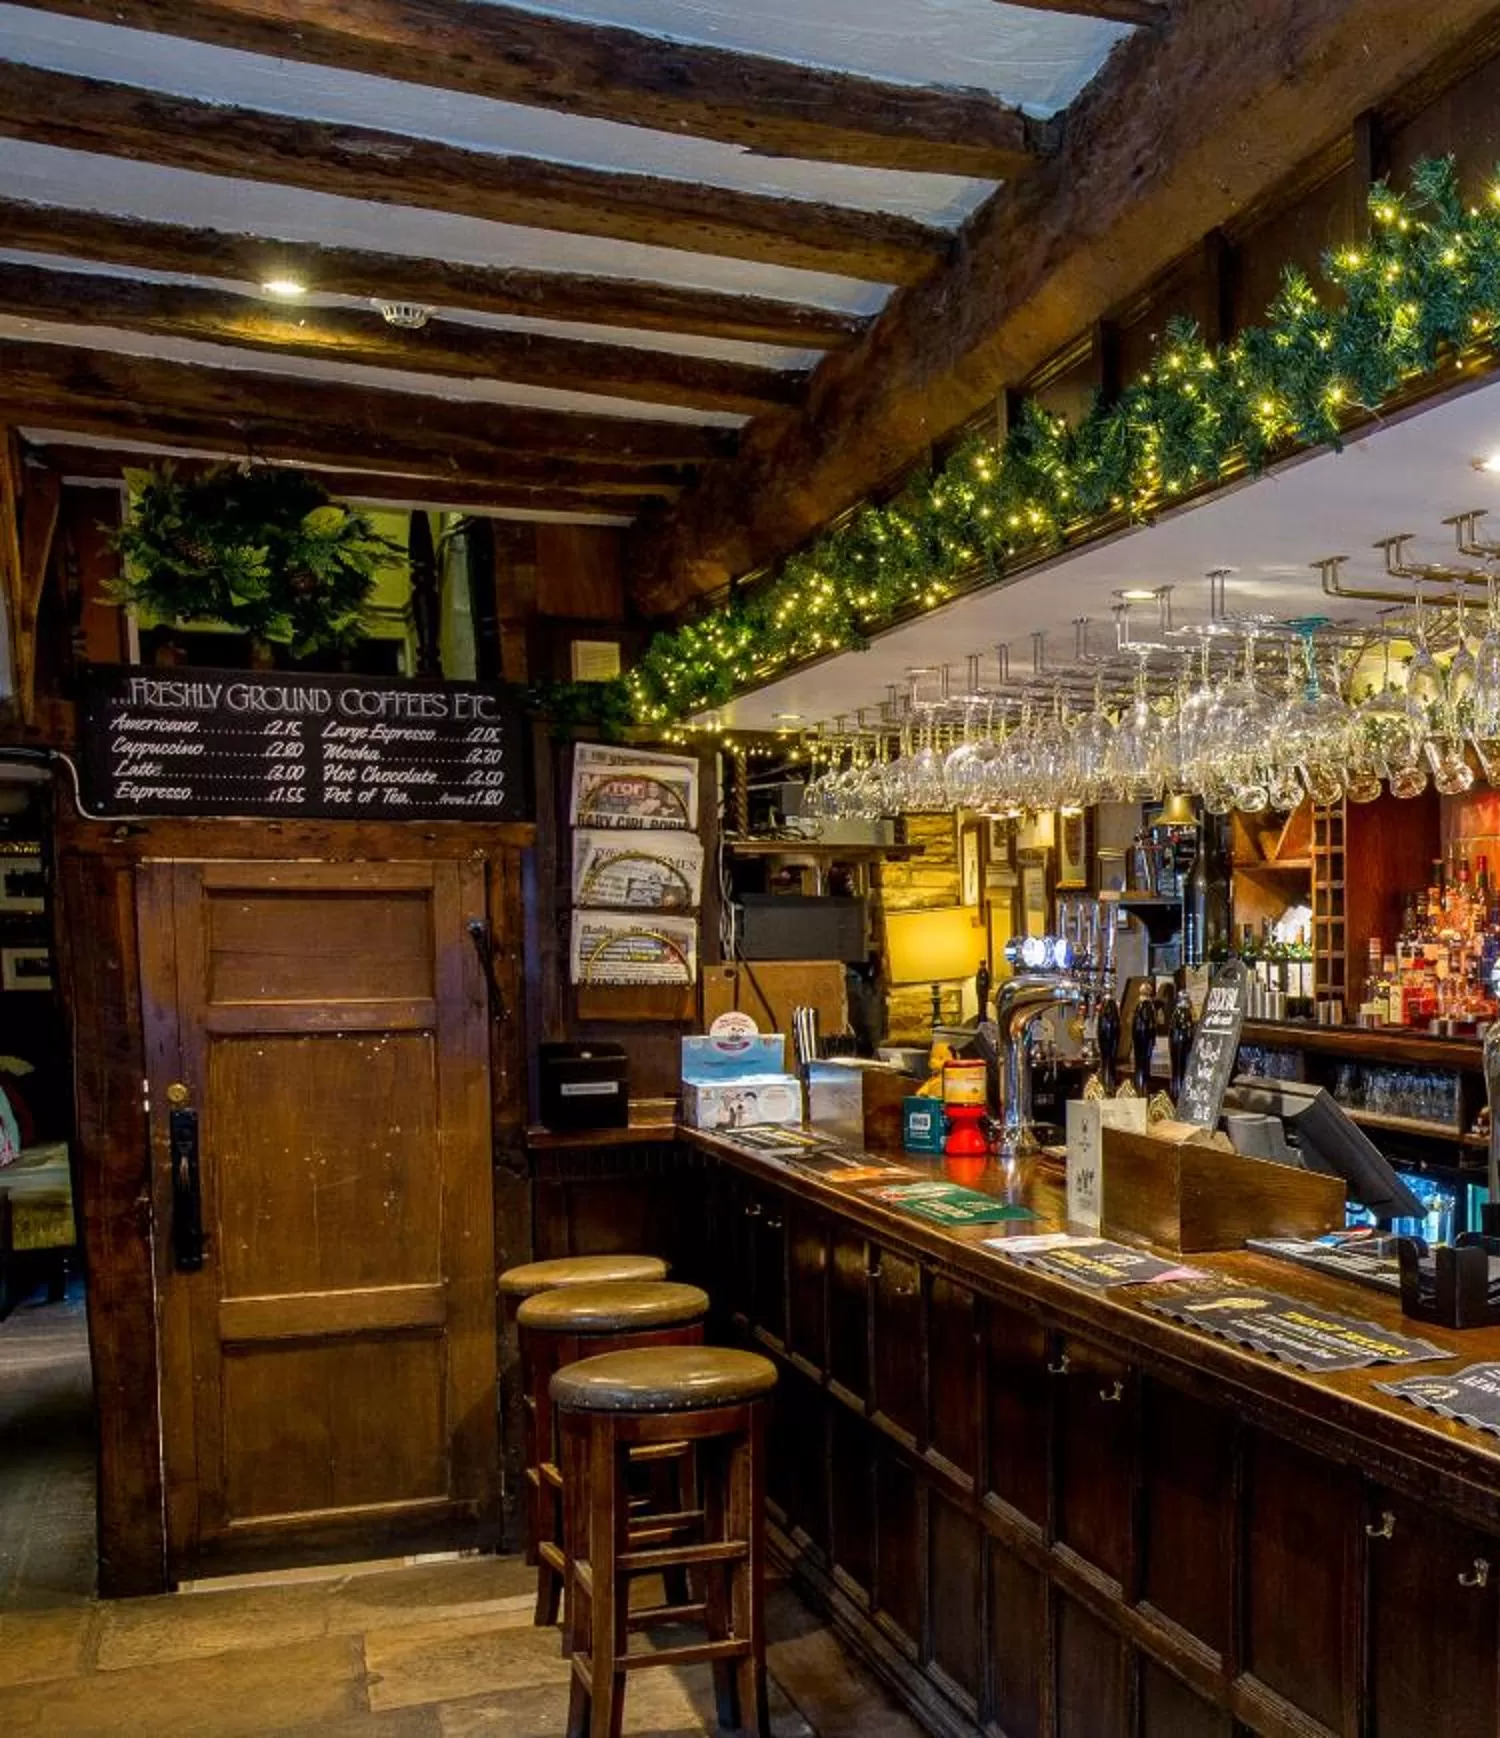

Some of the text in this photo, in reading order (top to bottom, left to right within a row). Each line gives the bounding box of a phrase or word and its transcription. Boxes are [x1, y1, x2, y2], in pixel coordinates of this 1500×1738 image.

[226, 683, 331, 713] GROUND
[340, 688, 448, 717] COFFEES
[109, 712, 199, 731] Americano
[320, 721, 368, 742] Large
[111, 736, 204, 759] Cappuccino
[323, 743, 381, 761] Mocha
[112, 759, 163, 777] Latte
[323, 764, 357, 782] Hot
[361, 765, 438, 784] Chocolate
[114, 781, 192, 803] Espresso
[323, 786, 353, 803] Pot
[358, 787, 378, 803] of
[382, 787, 409, 804] Tea
